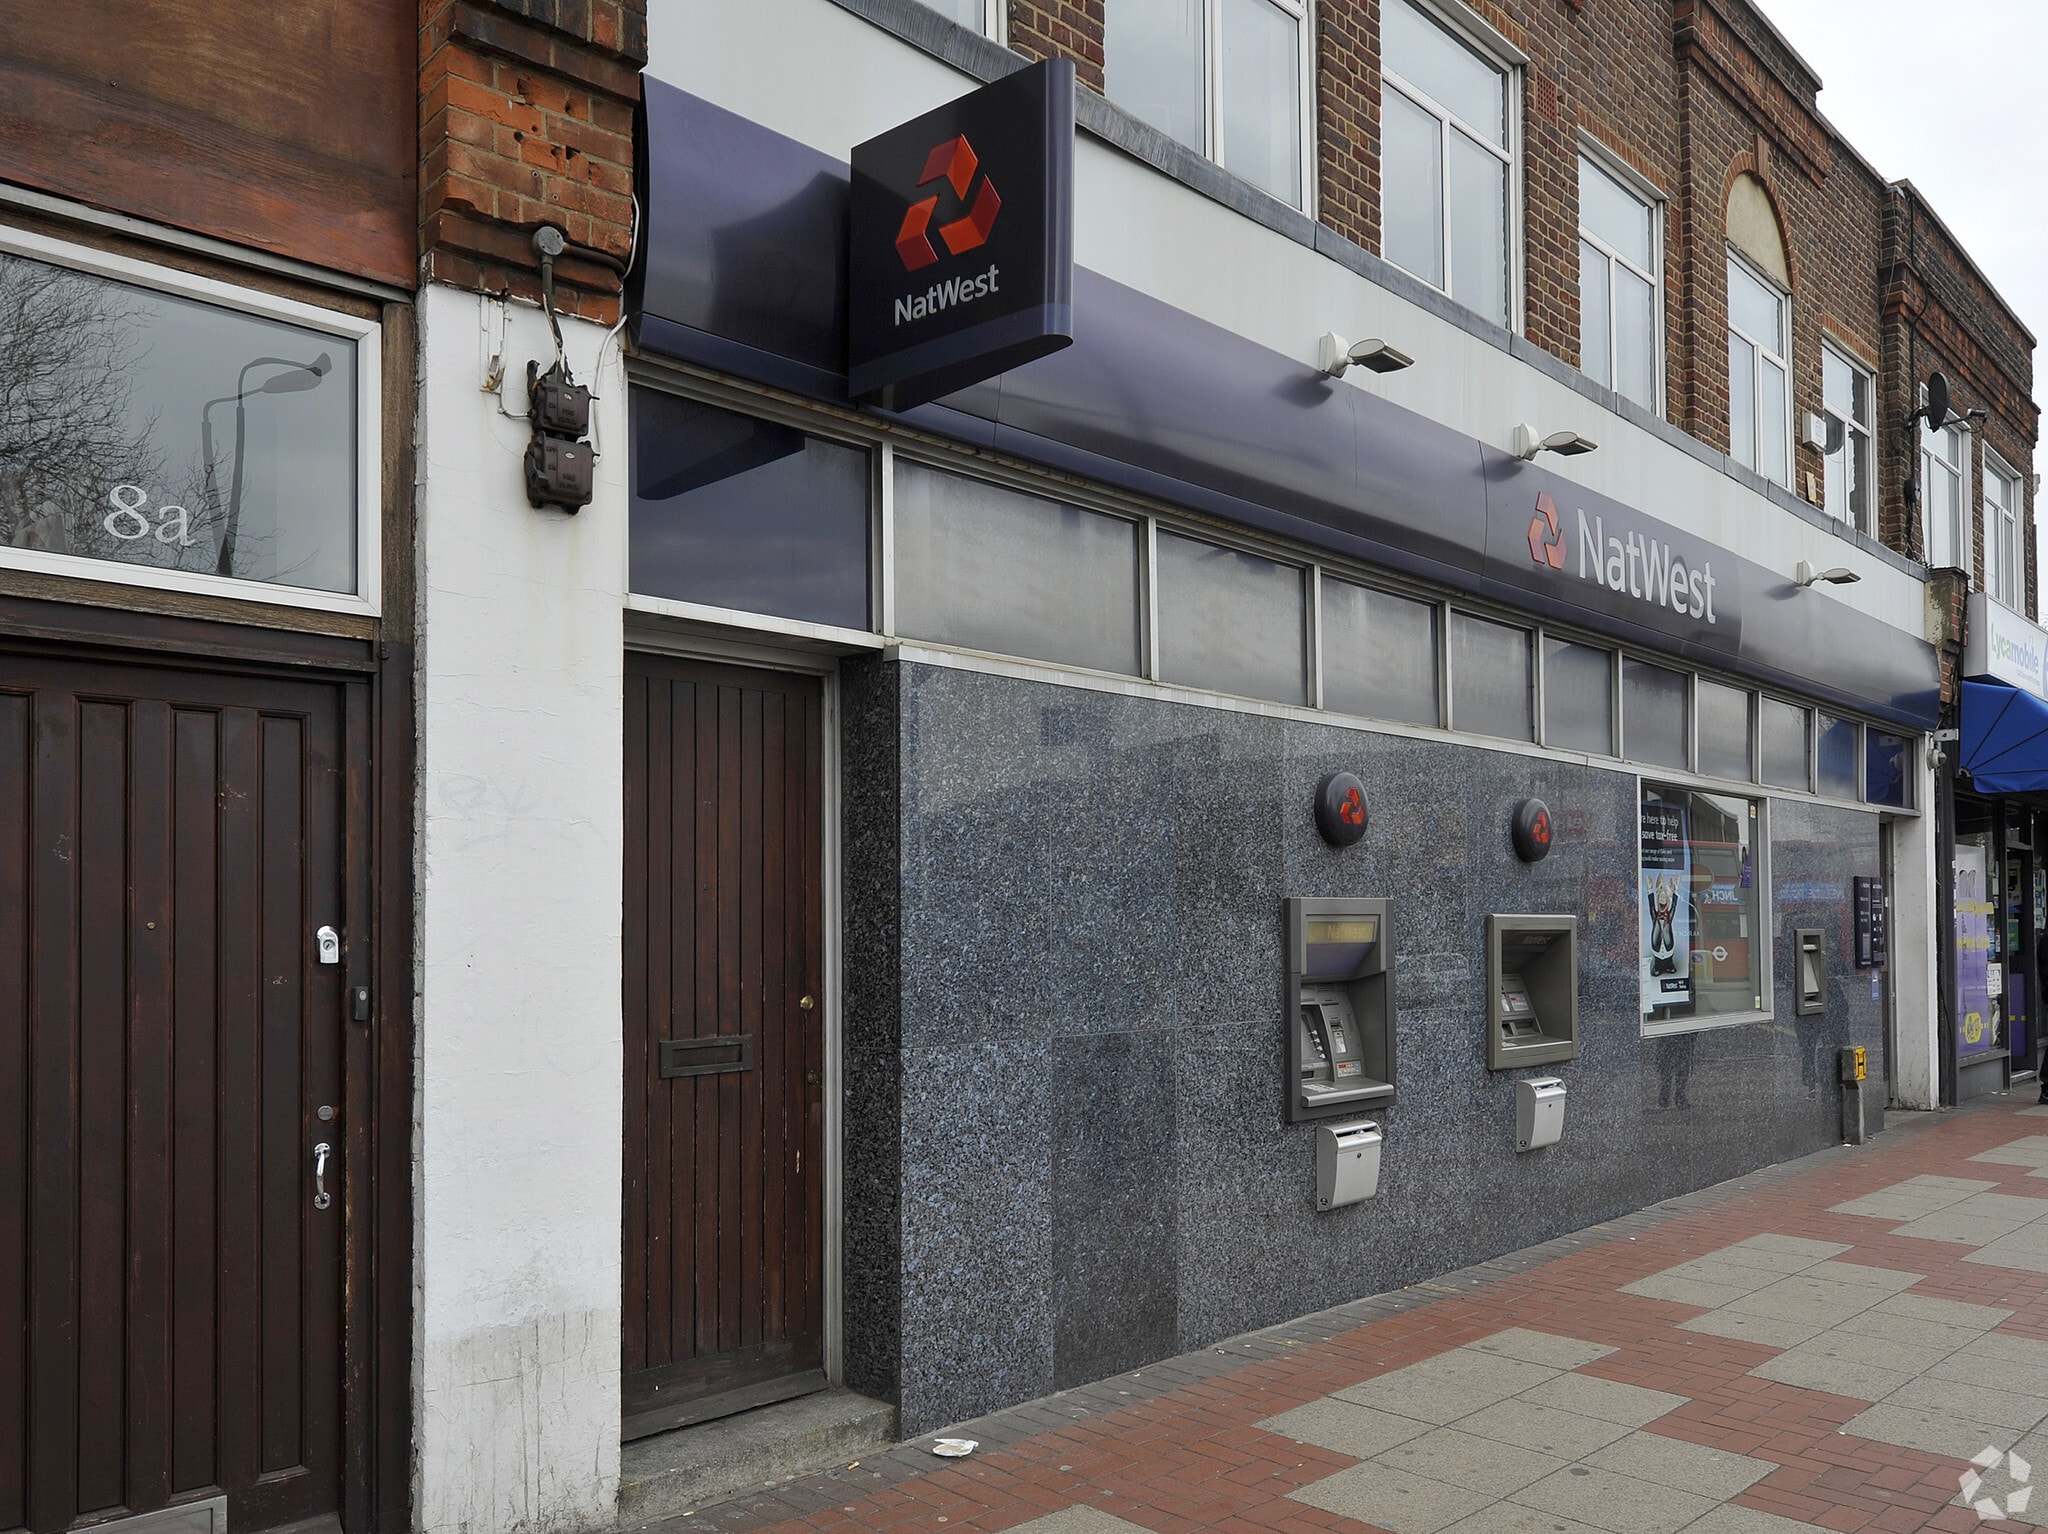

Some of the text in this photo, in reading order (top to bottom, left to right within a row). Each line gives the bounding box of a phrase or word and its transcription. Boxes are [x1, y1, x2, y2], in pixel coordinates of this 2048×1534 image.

[894, 263, 999, 326] NatWest
[103, 485, 196, 546] 8a
[1577, 507, 1716, 624] NatWest
[1991, 622, 2039, 674] Lycamobile
[1647, 812, 1659, 825] here
[1667, 815, 1679, 829] help
[1656, 830, 1678, 842] tax-free
